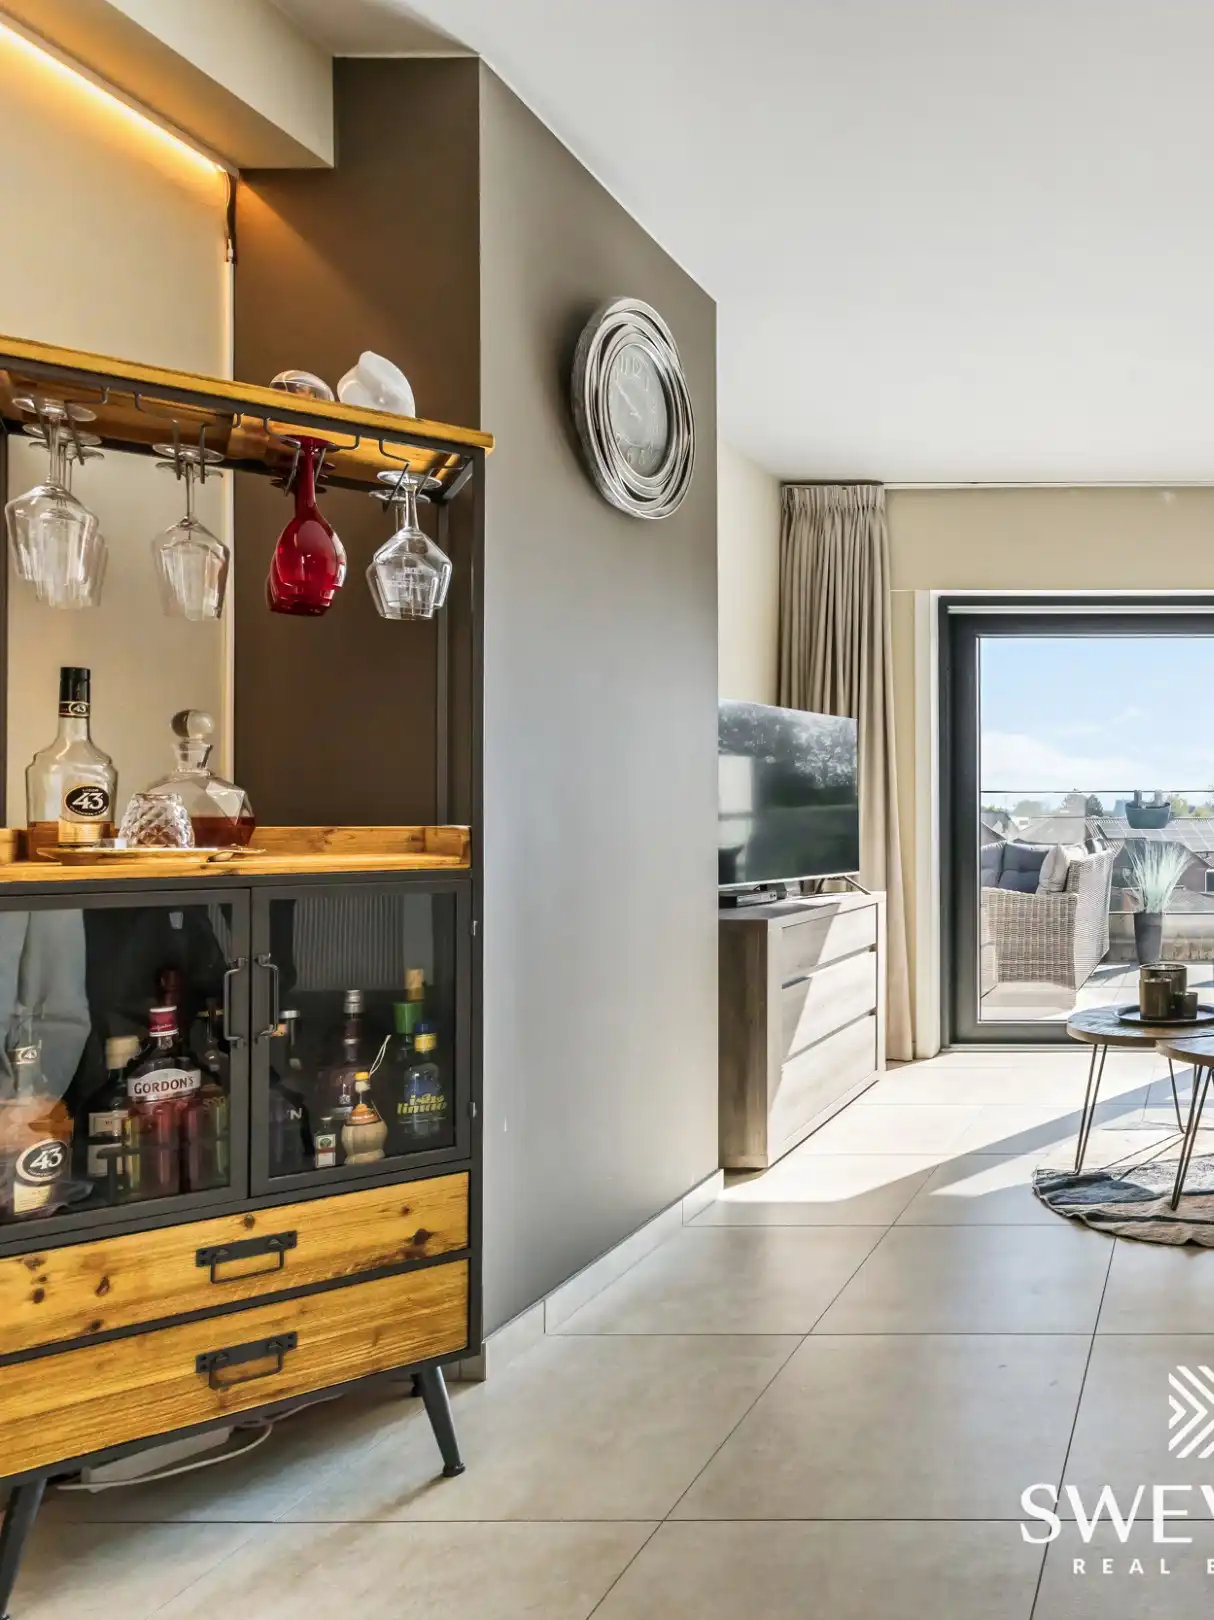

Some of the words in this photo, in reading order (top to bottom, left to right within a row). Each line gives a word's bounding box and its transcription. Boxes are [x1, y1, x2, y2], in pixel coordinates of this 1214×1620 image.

[72, 704, 87, 713] 43
[72, 792, 104, 810] 43
[133, 1075, 194, 1095] GORDON'S
[29, 1146, 63, 1170] 43
